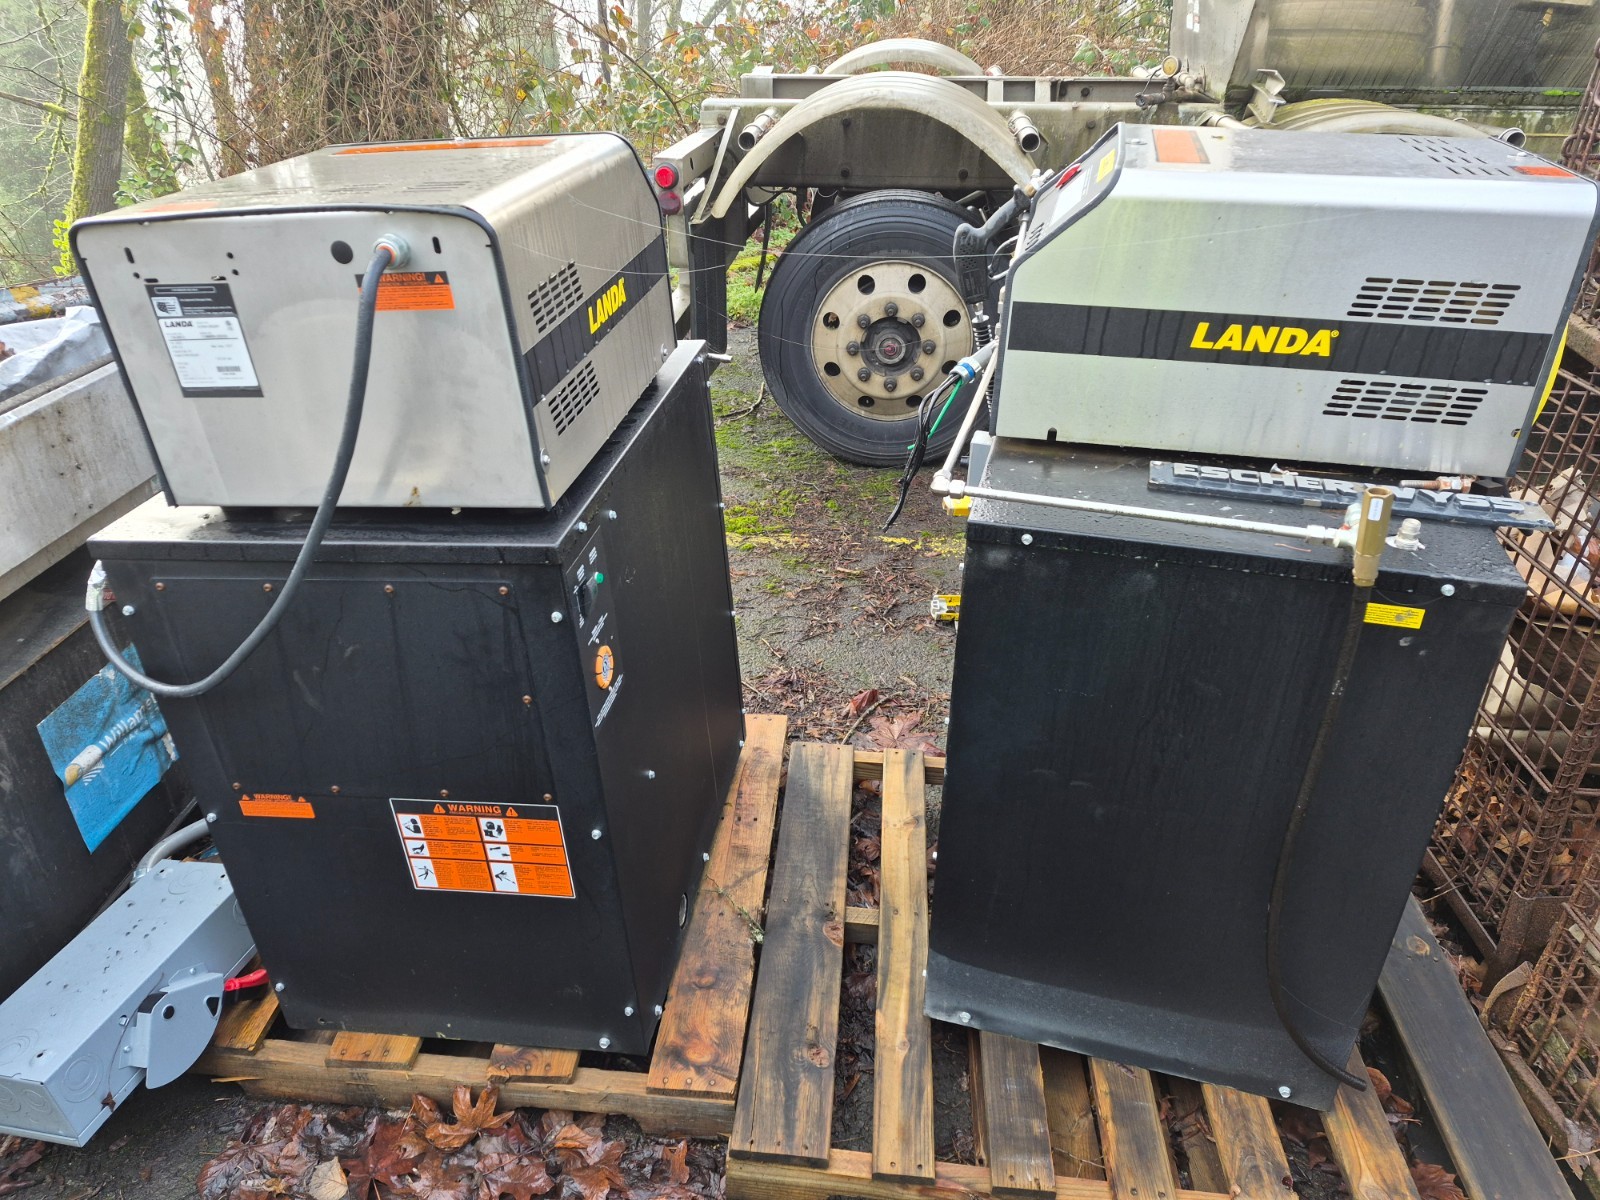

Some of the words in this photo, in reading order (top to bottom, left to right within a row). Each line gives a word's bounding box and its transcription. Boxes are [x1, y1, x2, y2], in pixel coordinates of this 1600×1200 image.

[587, 276, 627, 335] LANDA
[164, 319, 193, 328] LANDA
[1189, 321, 1332, 357] LANDA
[1172, 461, 1358, 496] ESCHER
[447, 803, 502, 814] WARNING
